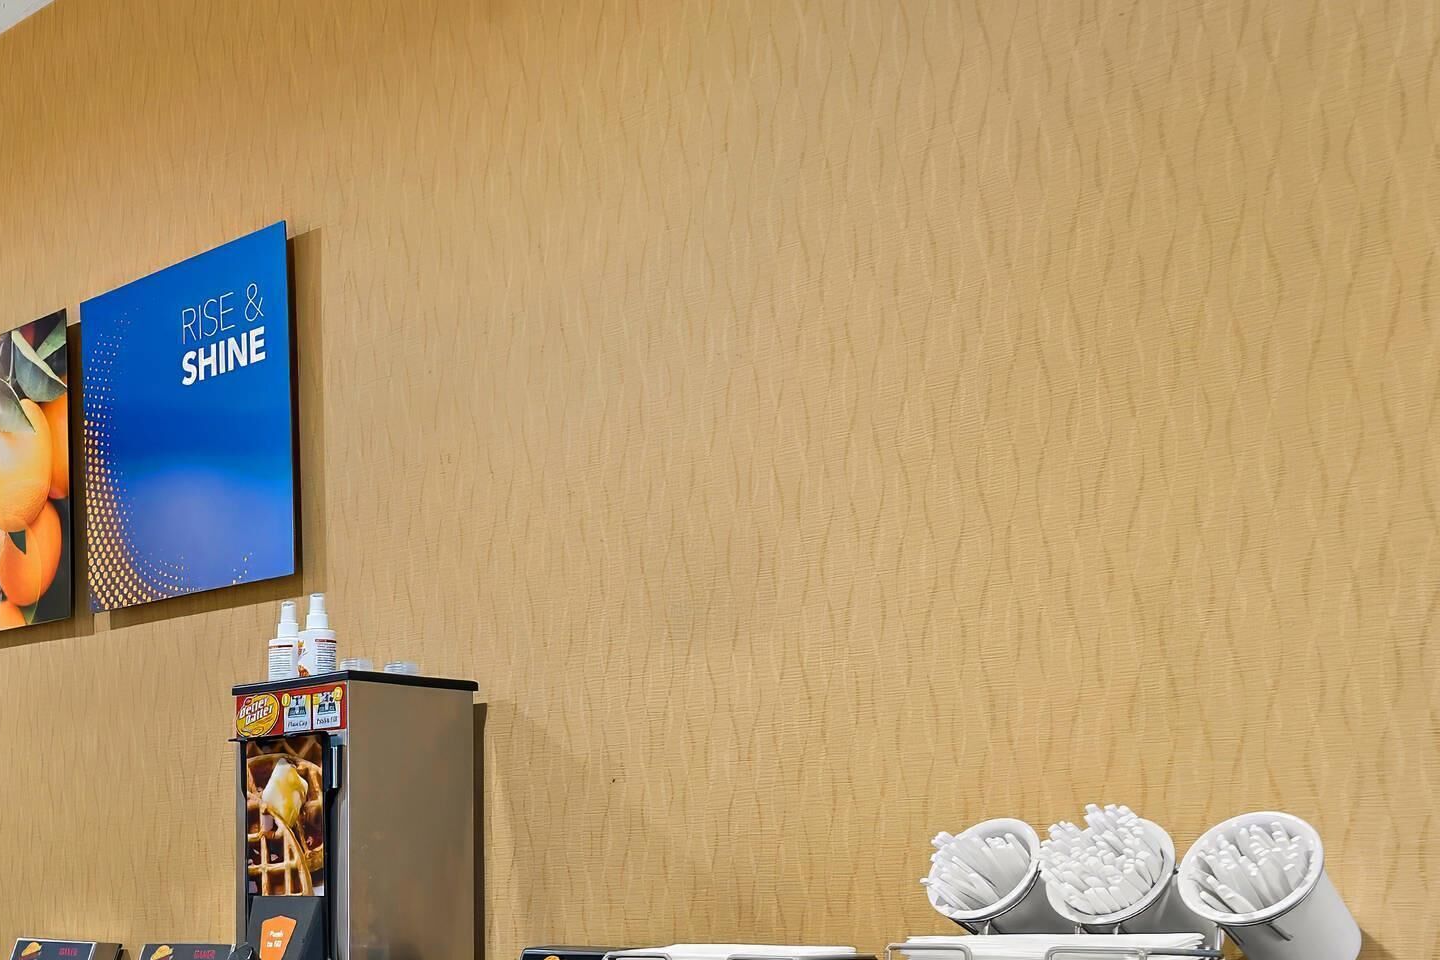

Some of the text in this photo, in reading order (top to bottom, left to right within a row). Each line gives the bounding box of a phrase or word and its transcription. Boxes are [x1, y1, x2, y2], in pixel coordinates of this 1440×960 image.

[182, 283, 264, 345] RISE &
[181, 325, 266, 386] SHINE
